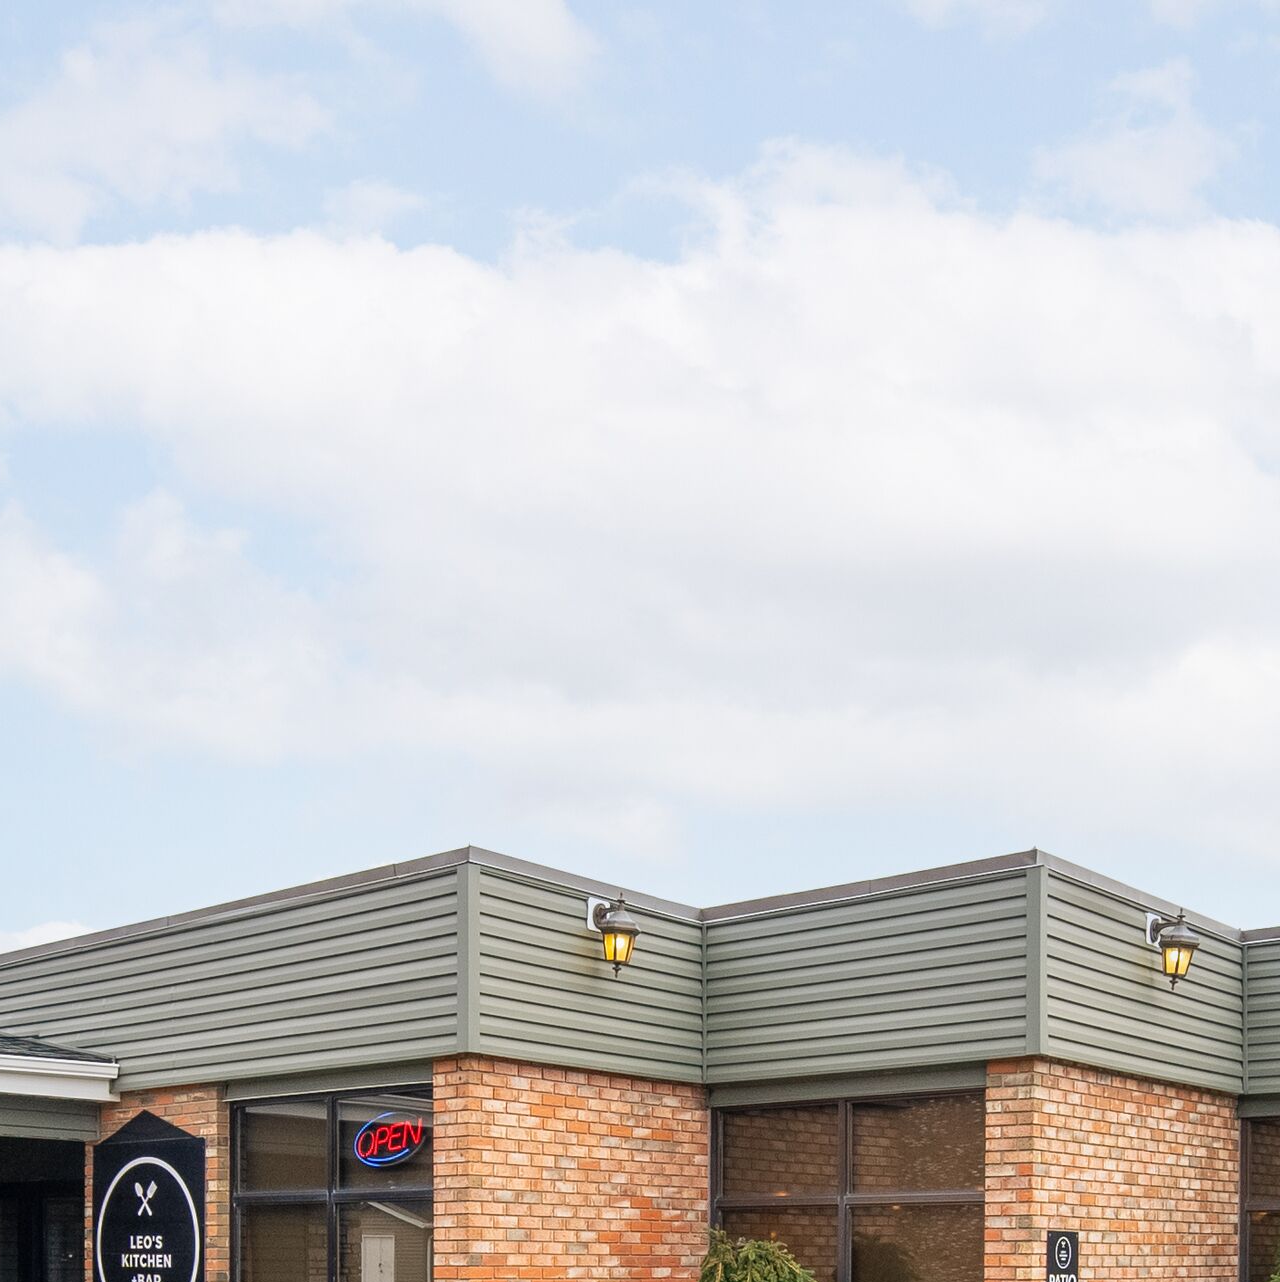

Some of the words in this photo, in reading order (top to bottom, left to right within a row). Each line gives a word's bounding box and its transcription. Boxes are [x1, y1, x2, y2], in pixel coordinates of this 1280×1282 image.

[357, 1116, 423, 1158] OPEN
[129, 1235, 163, 1249] LEO'S
[121, 1253, 172, 1268] KITCHEN
